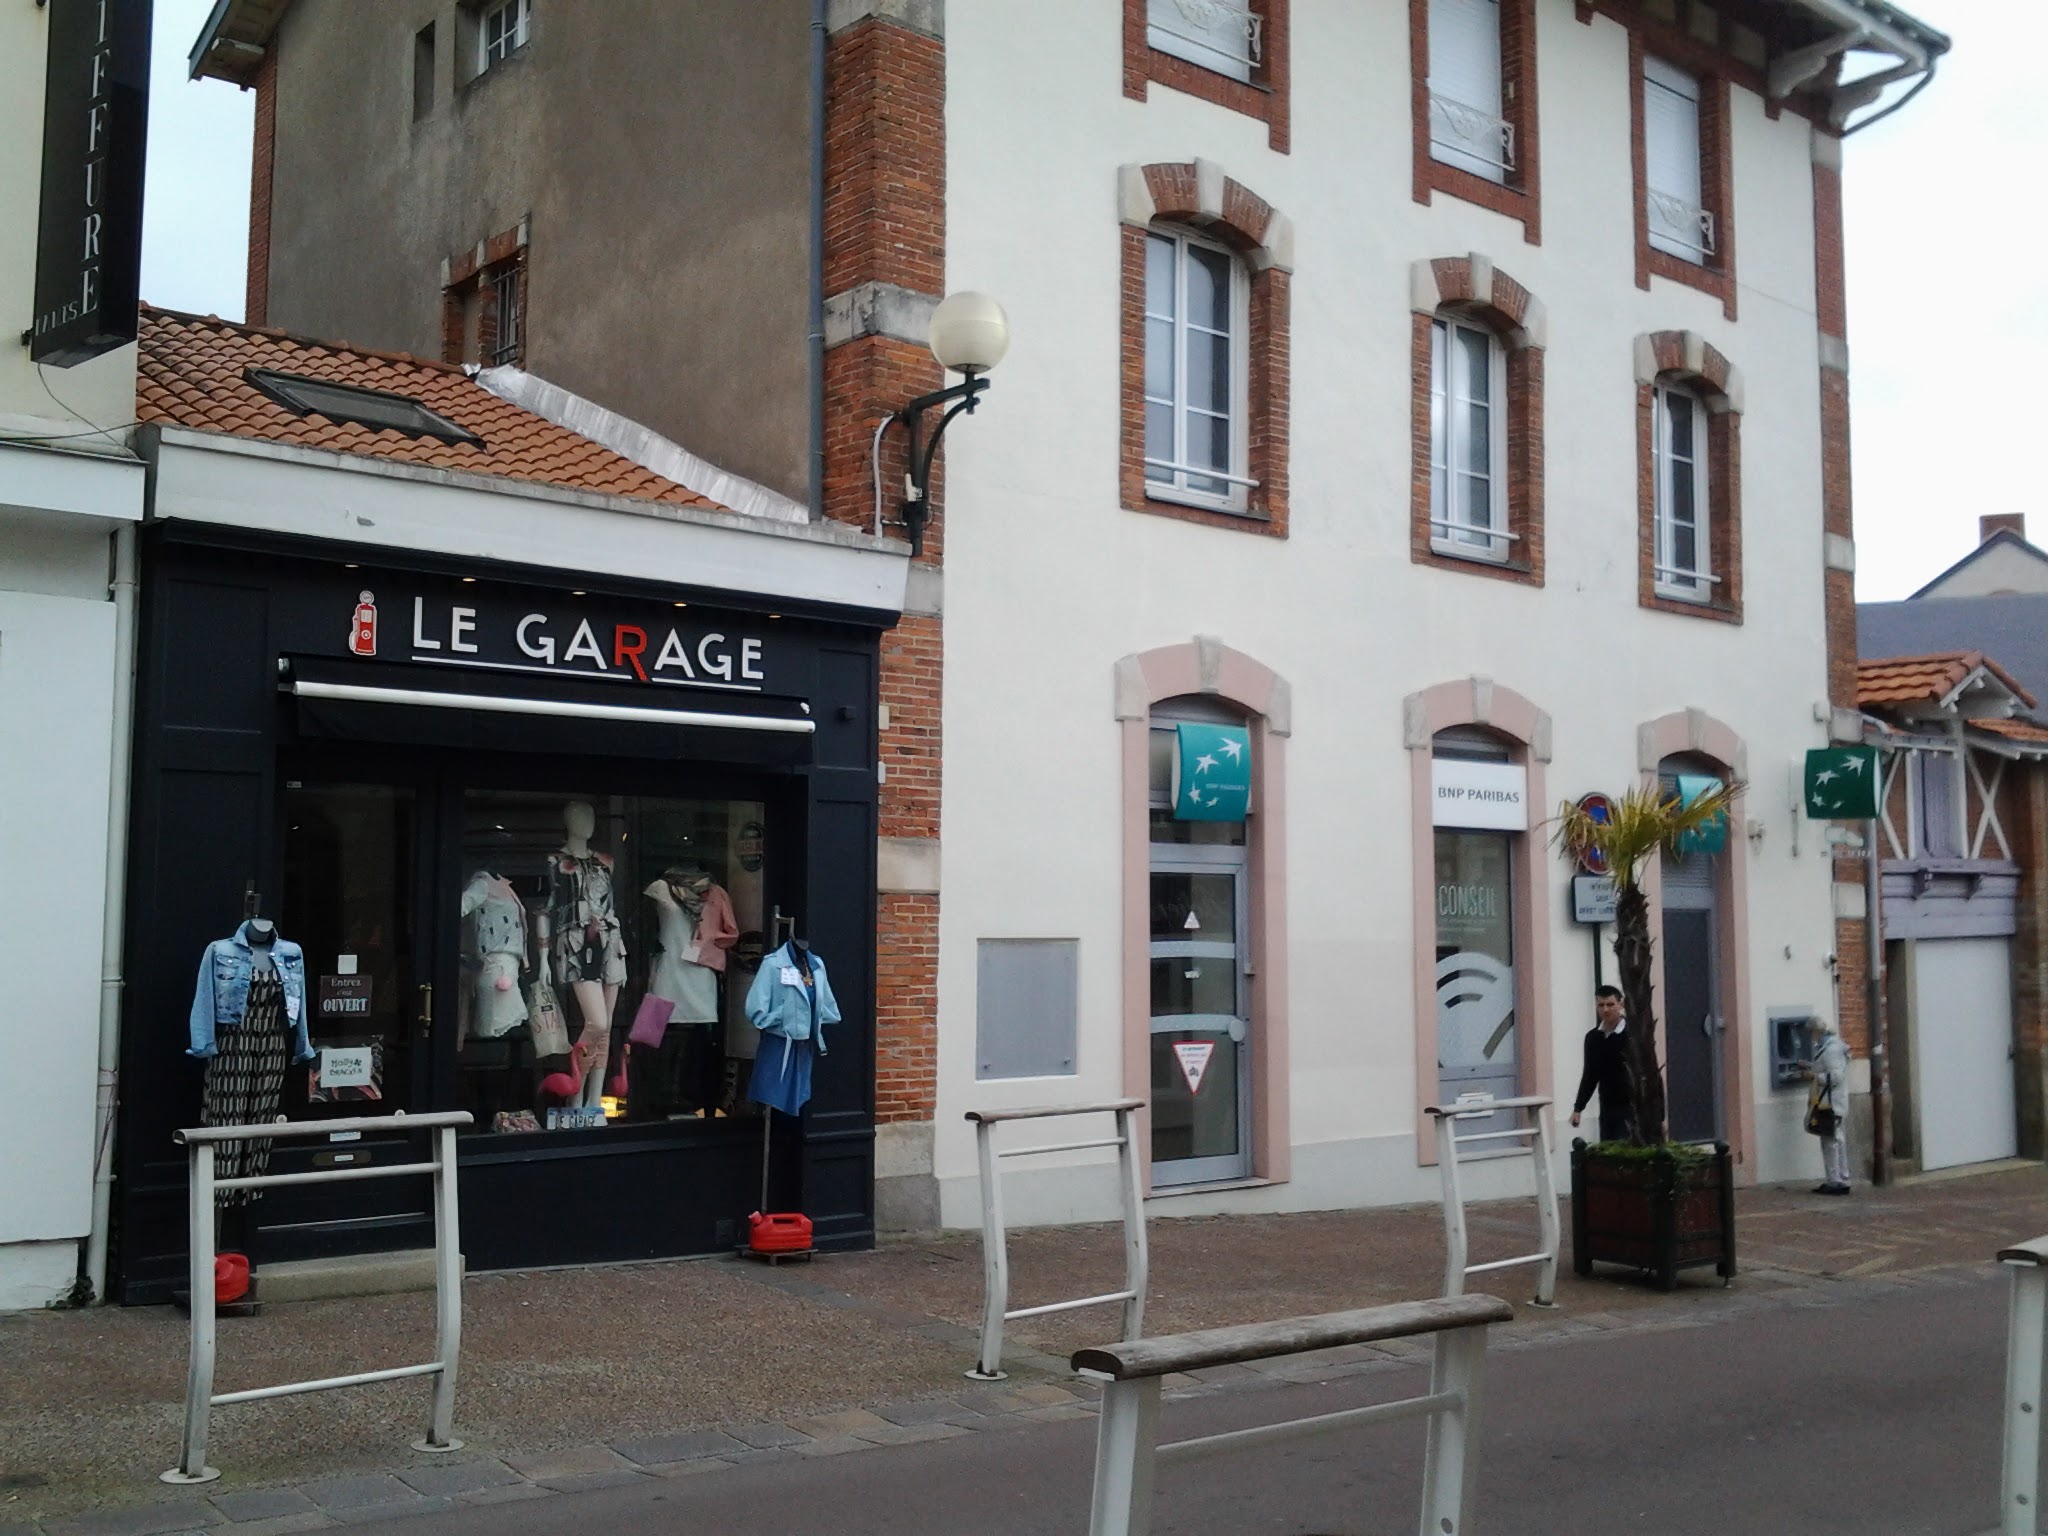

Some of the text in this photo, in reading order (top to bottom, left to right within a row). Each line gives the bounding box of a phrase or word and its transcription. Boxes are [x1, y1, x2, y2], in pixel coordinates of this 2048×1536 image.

[413, 596, 764, 681] LE GARAGE
[1438, 787, 1520, 803] BNP PARIBAS
[1438, 885, 1496, 916] CONSEIL
[331, 978, 362, 988] Entrez
[323, 998, 368, 1012] OUVERT
